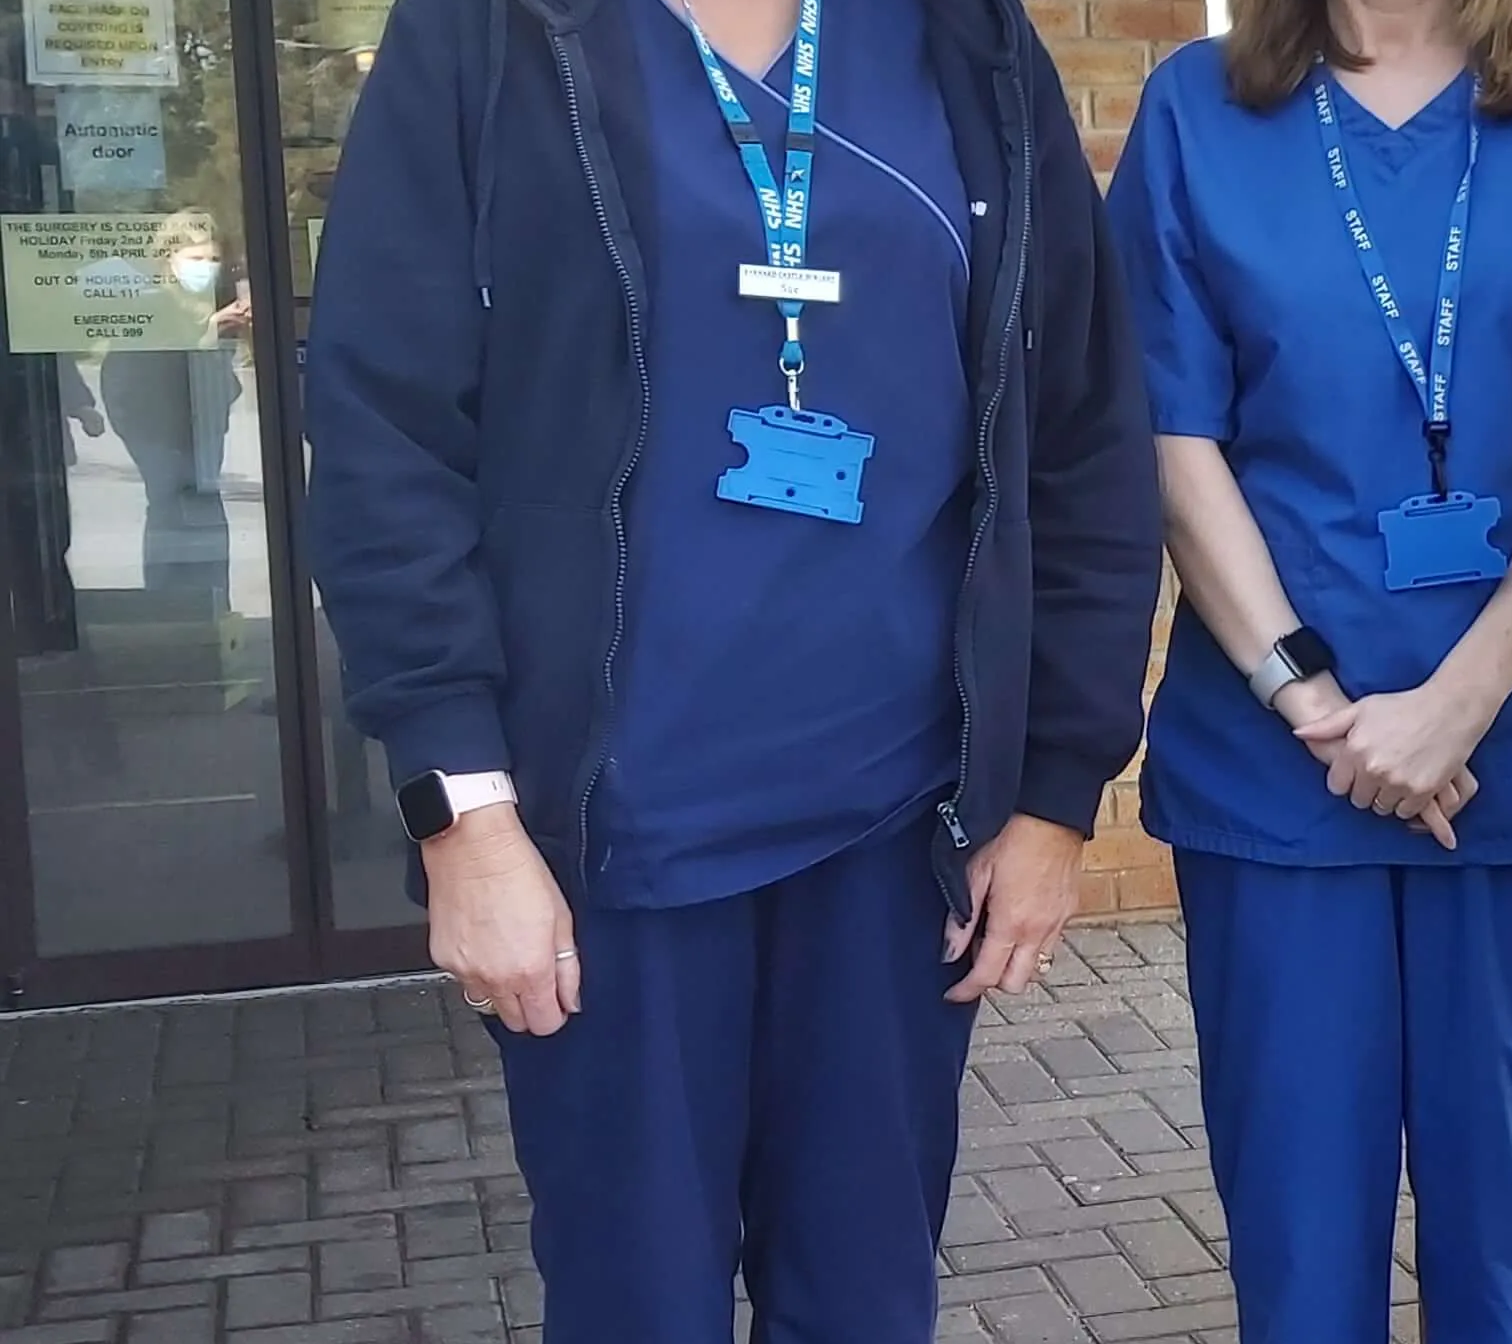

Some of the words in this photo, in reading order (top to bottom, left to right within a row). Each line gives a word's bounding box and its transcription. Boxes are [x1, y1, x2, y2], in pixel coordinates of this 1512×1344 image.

[796, 39, 814, 77] NHS
[65, 122, 159, 137] Automatic
[92, 146, 135, 158] door
[708, 66, 738, 104] NHS
[759, 187, 782, 230] NHS
[784, 188, 805, 230] NHS
[7, 221, 33, 233] THE
[35, 221, 97, 233] SURGERY
[100, 222, 113, 233] IS
[1314, 83, 1334, 126] STAFF
[1328, 147, 1348, 190] STAFF
[1345, 209, 1373, 251] STAFF
[1372, 274, 1400, 320] STAFF
[1400, 341, 1427, 385] STAFF
[20, 235, 76, 247] HOLIDAY
[80, 235, 118, 248] Friday
[120, 235, 142, 246] 2nd
[1445, 225, 1462, 272] STAFF
[38, 249, 84, 261] Monday
[112, 249, 146, 259] APRIL
[34, 276, 61, 287] OUT
[86, 275, 131, 286] HOURS
[83, 288, 116, 299] CALL
[74, 314, 154, 326] EMERGENCY
[1437, 297, 1454, 347] STAFF
[86, 328, 120, 338] CALL
[1432, 373, 1447, 422] STAFF
